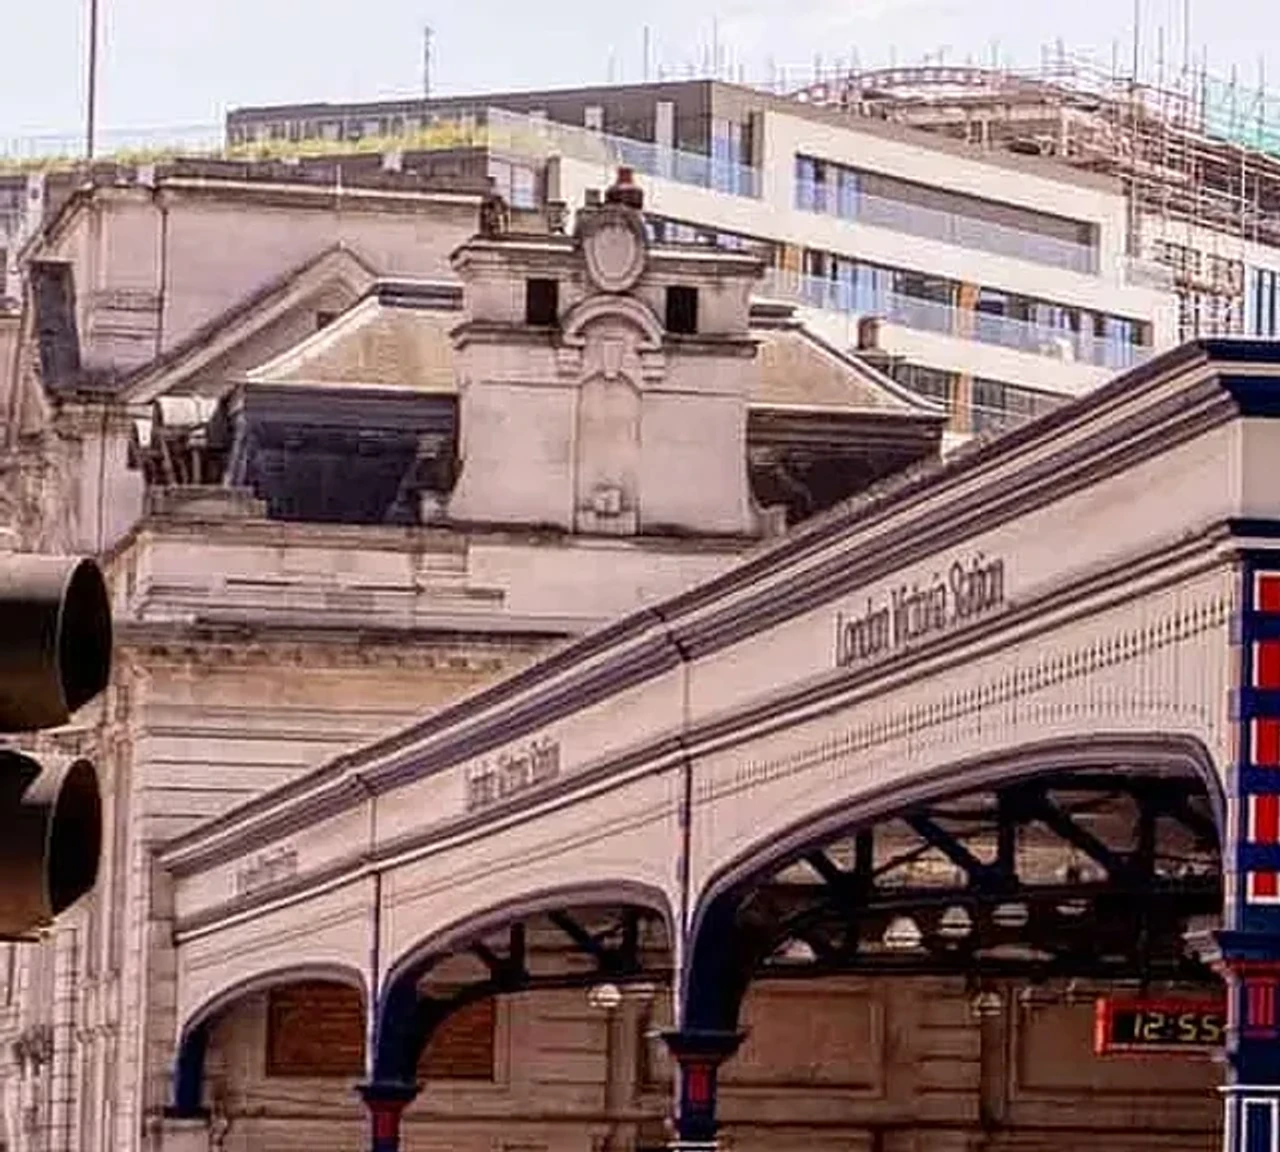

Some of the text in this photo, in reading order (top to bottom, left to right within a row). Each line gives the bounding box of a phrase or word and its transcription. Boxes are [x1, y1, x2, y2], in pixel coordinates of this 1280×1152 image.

[836, 552, 1004, 667] London Victoria Station
[1133, 1012, 1220, 1041] 12:55
